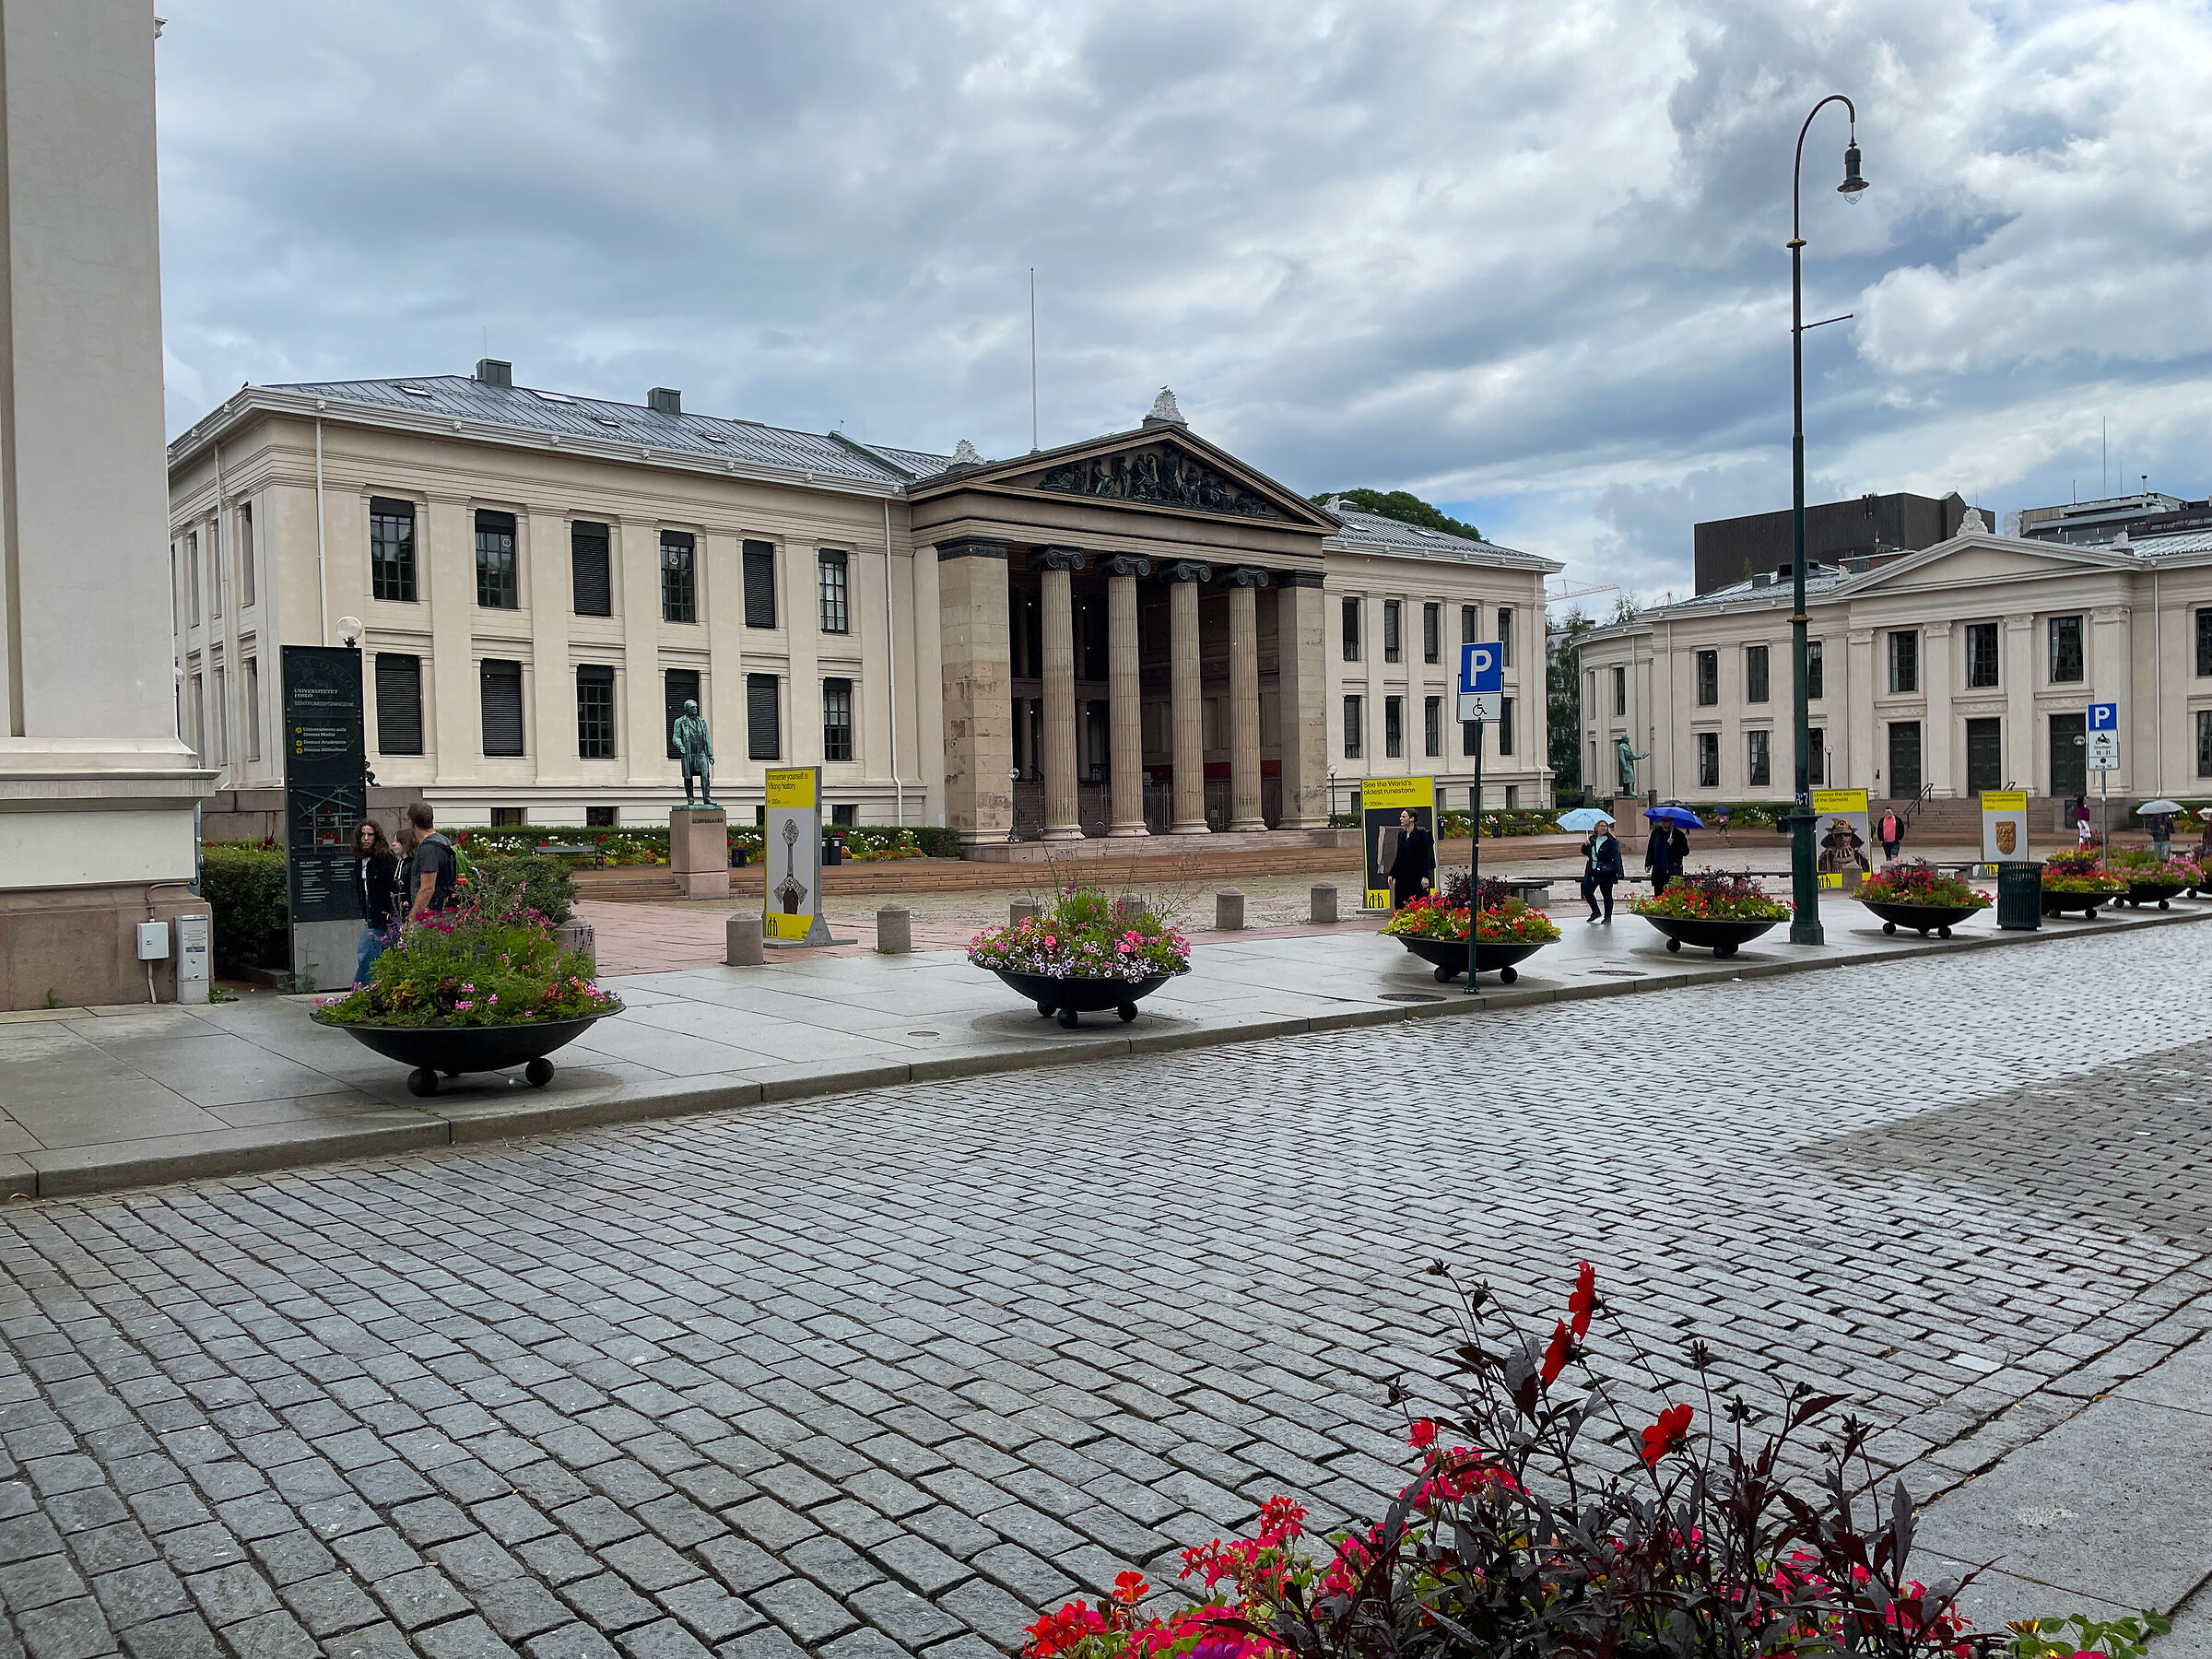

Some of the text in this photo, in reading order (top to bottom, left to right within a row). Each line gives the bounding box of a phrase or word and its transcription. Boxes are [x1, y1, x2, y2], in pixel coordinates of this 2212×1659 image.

[1470, 649, 1492, 687] P
[2094, 706, 2111, 728] P
[786, 771, 804, 782] yourself
[767, 782, 795, 792] Viking history
[1387, 779, 1412, 787] World's
